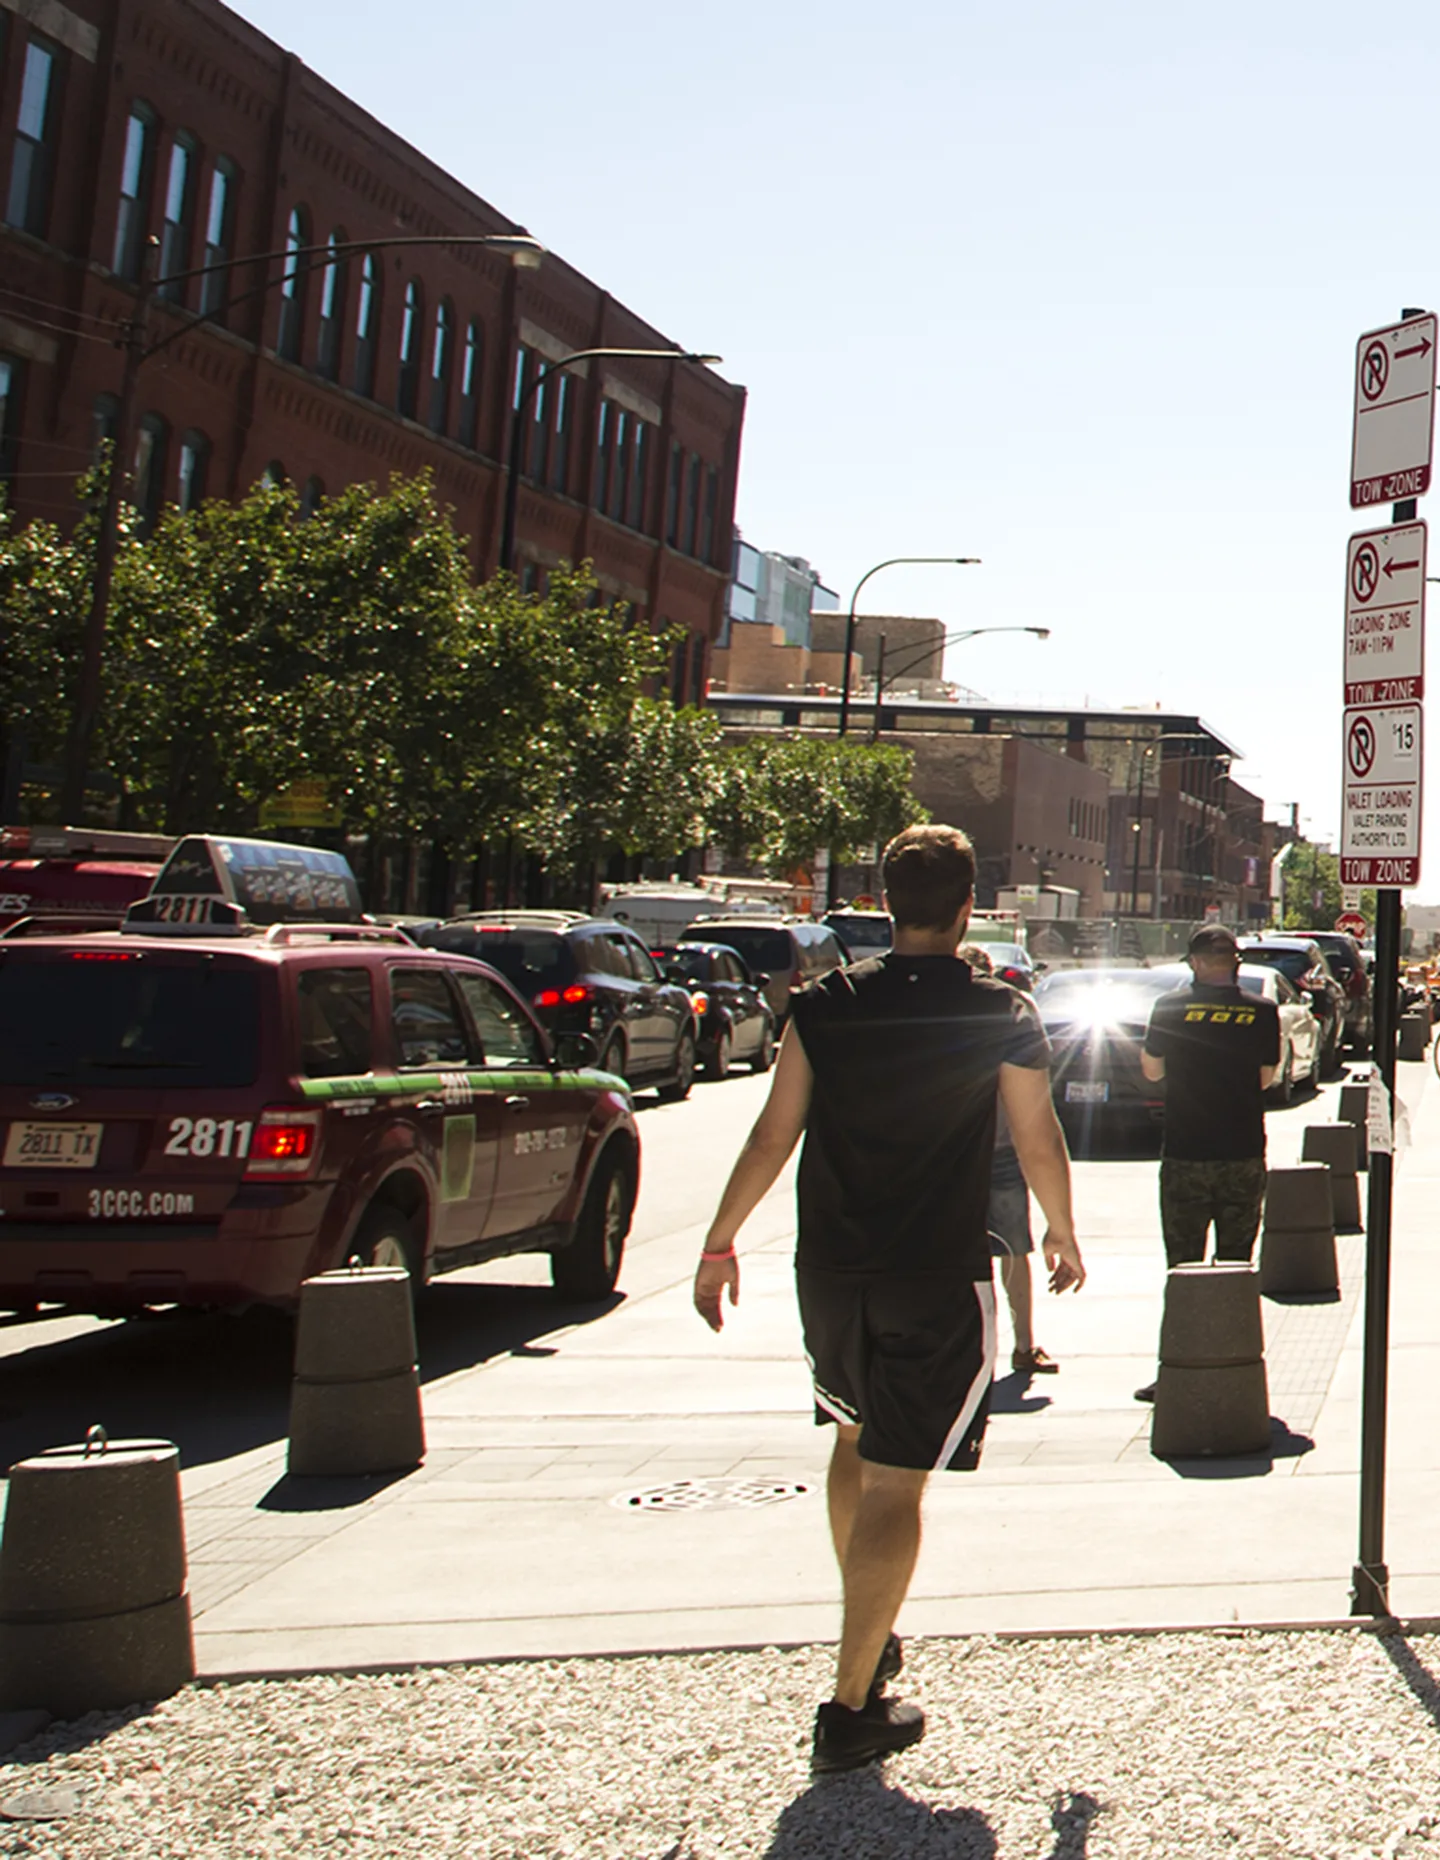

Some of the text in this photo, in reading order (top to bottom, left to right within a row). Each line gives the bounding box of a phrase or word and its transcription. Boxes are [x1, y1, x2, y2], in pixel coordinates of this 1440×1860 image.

[1355, 469, 1423, 504] TOW ZONE
[1349, 610, 1411, 635] LOADING ZONE
[1348, 680, 1416, 705] TOW ZONE
[1392, 722, 1415, 750] $15
[1347, 789, 1413, 810] VALET LOADING
[1353, 813, 1408, 828] VALET PARKING
[1343, 859, 1413, 883] TOW ZONE
[157, 895, 211, 924] 2811
[18, 1132, 97, 1155] 2811 TX
[164, 1116, 254, 1159] 2811
[88, 1188, 195, 1218] 3CCC.COM
